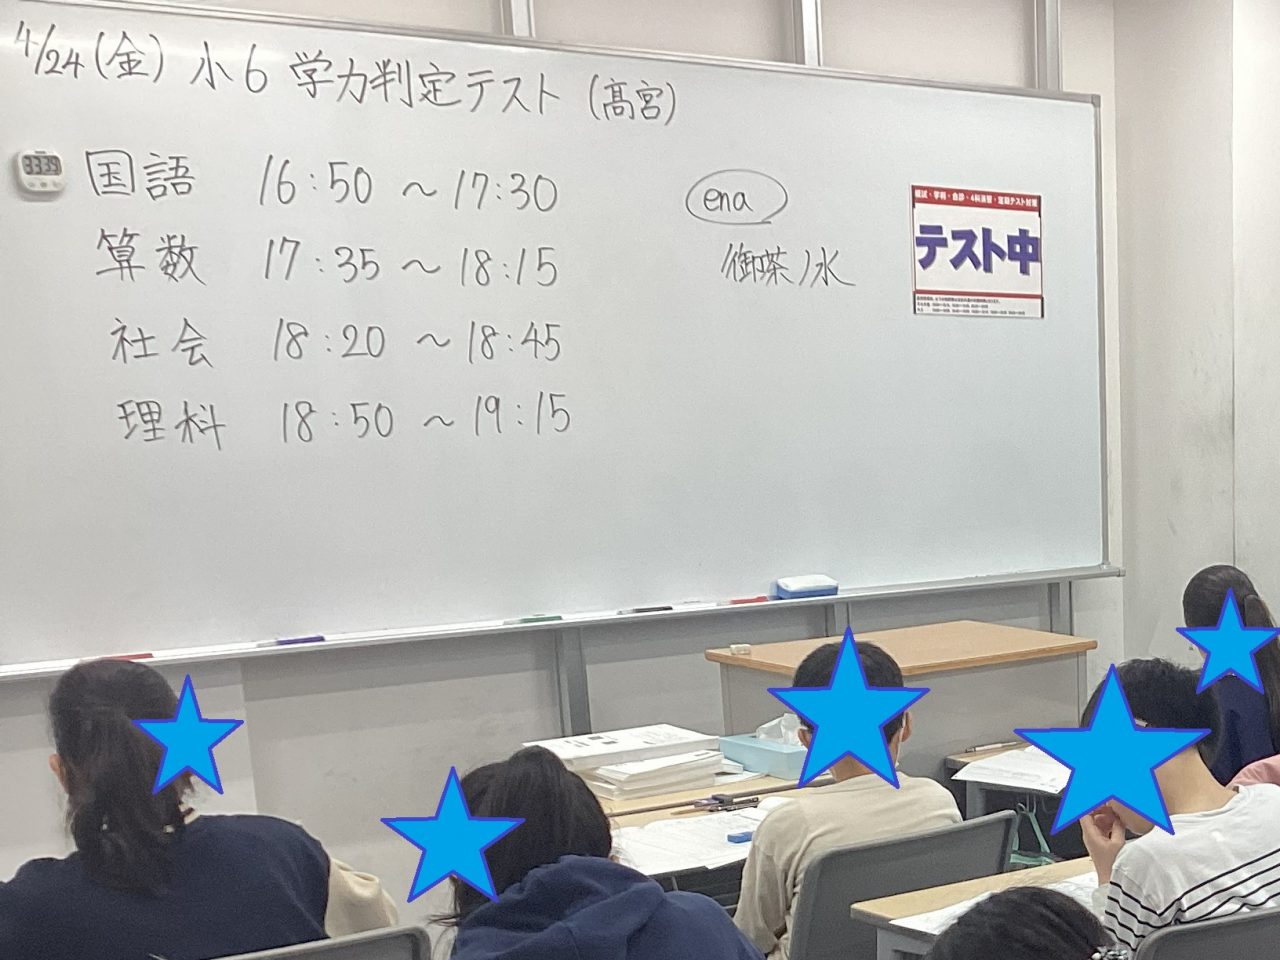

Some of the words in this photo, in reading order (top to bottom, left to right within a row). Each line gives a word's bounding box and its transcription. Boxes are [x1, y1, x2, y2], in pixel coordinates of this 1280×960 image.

[189, 40, 268, 94] 小6
[288, 50, 561, 115] 学力判定テスト
[84, 149, 196, 202] 国語
[259, 153, 373, 206] 16:50
[702, 187, 754, 213] ena
[95, 226, 207, 286] 算数
[264, 235, 381, 284] 17:35
[915, 224, 1041, 276] テスト中
[110, 316, 214, 369] 社会
[273, 317, 386, 362] 18:20
[116, 399, 227, 451] 理科
[282, 400, 394, 444] 18:50
